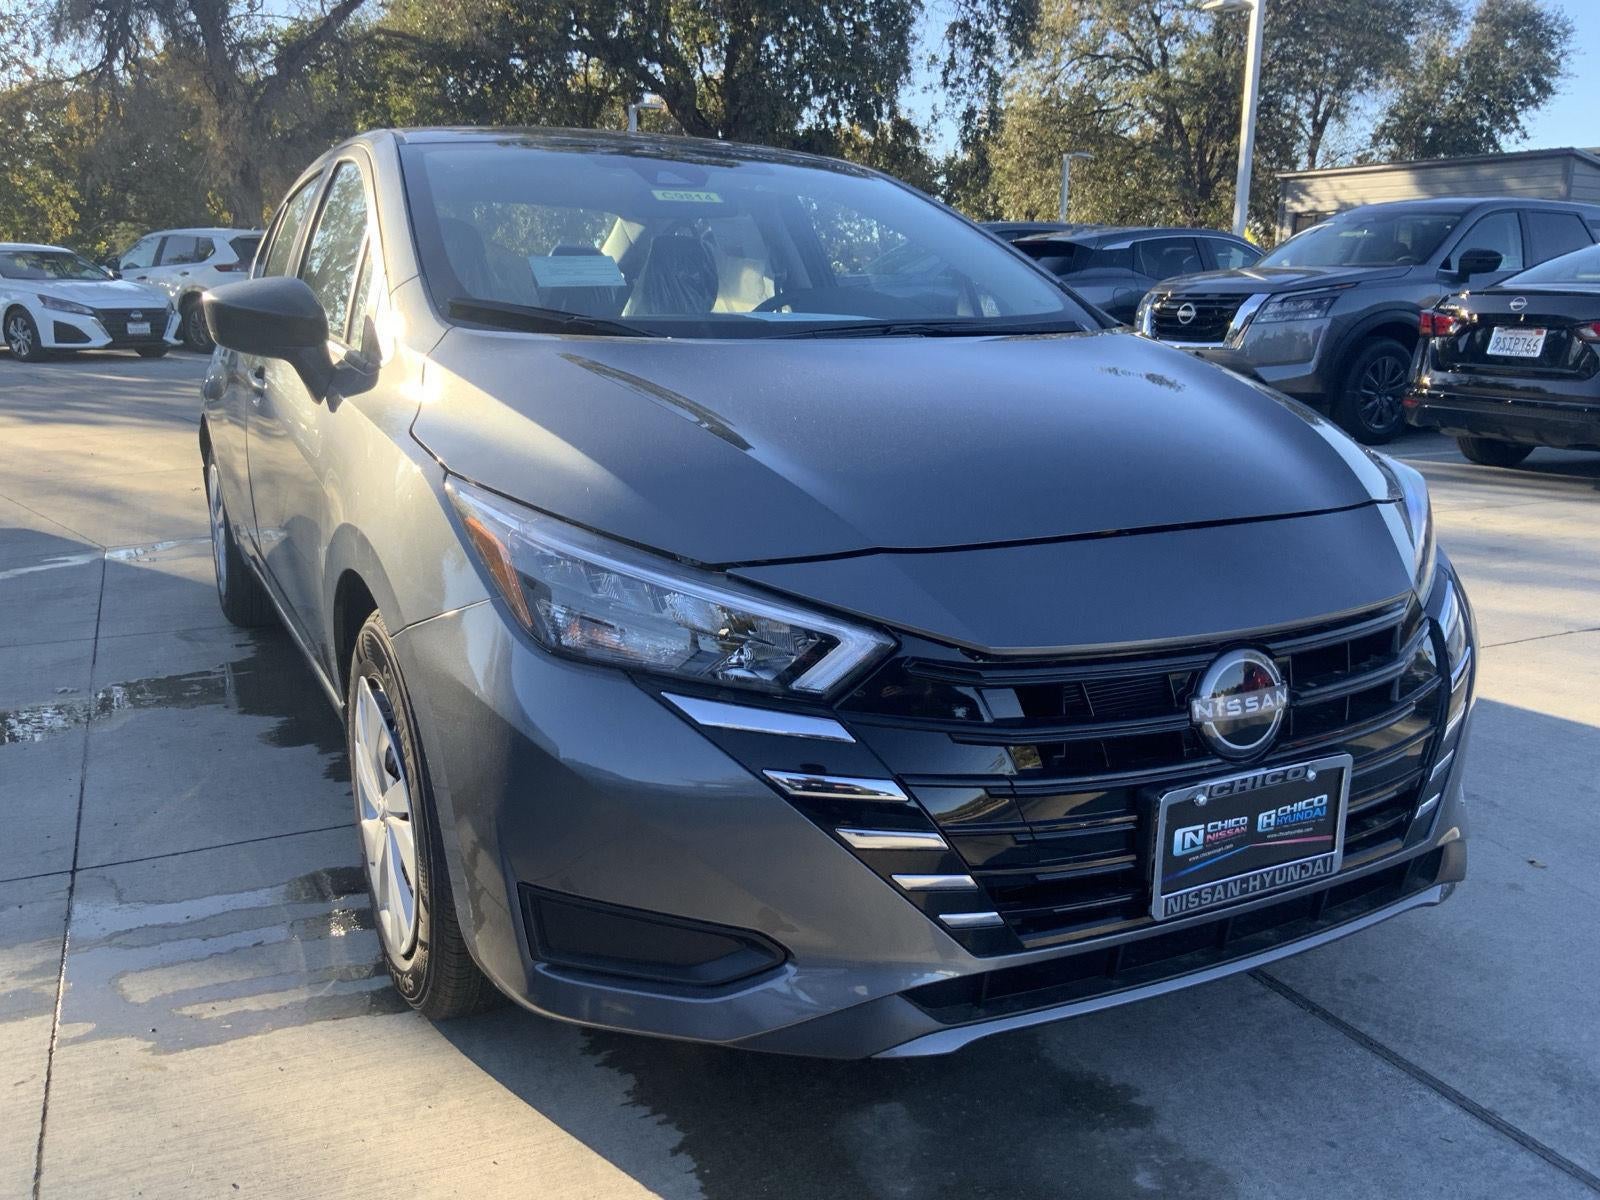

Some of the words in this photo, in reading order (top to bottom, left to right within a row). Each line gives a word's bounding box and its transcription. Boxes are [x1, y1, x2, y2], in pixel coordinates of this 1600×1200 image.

[1193, 685, 1287, 719] NISSAN
[1210, 766, 1306, 797] CHICO
[1276, 806, 1327, 825] HYUNDAI
[1277, 794, 1328, 816] CHICO
[1206, 826, 1248, 842] NISSAN
[1207, 816, 1248, 832] CHICO
[1167, 857, 1334, 914] NISSAN-HYUNDAI
